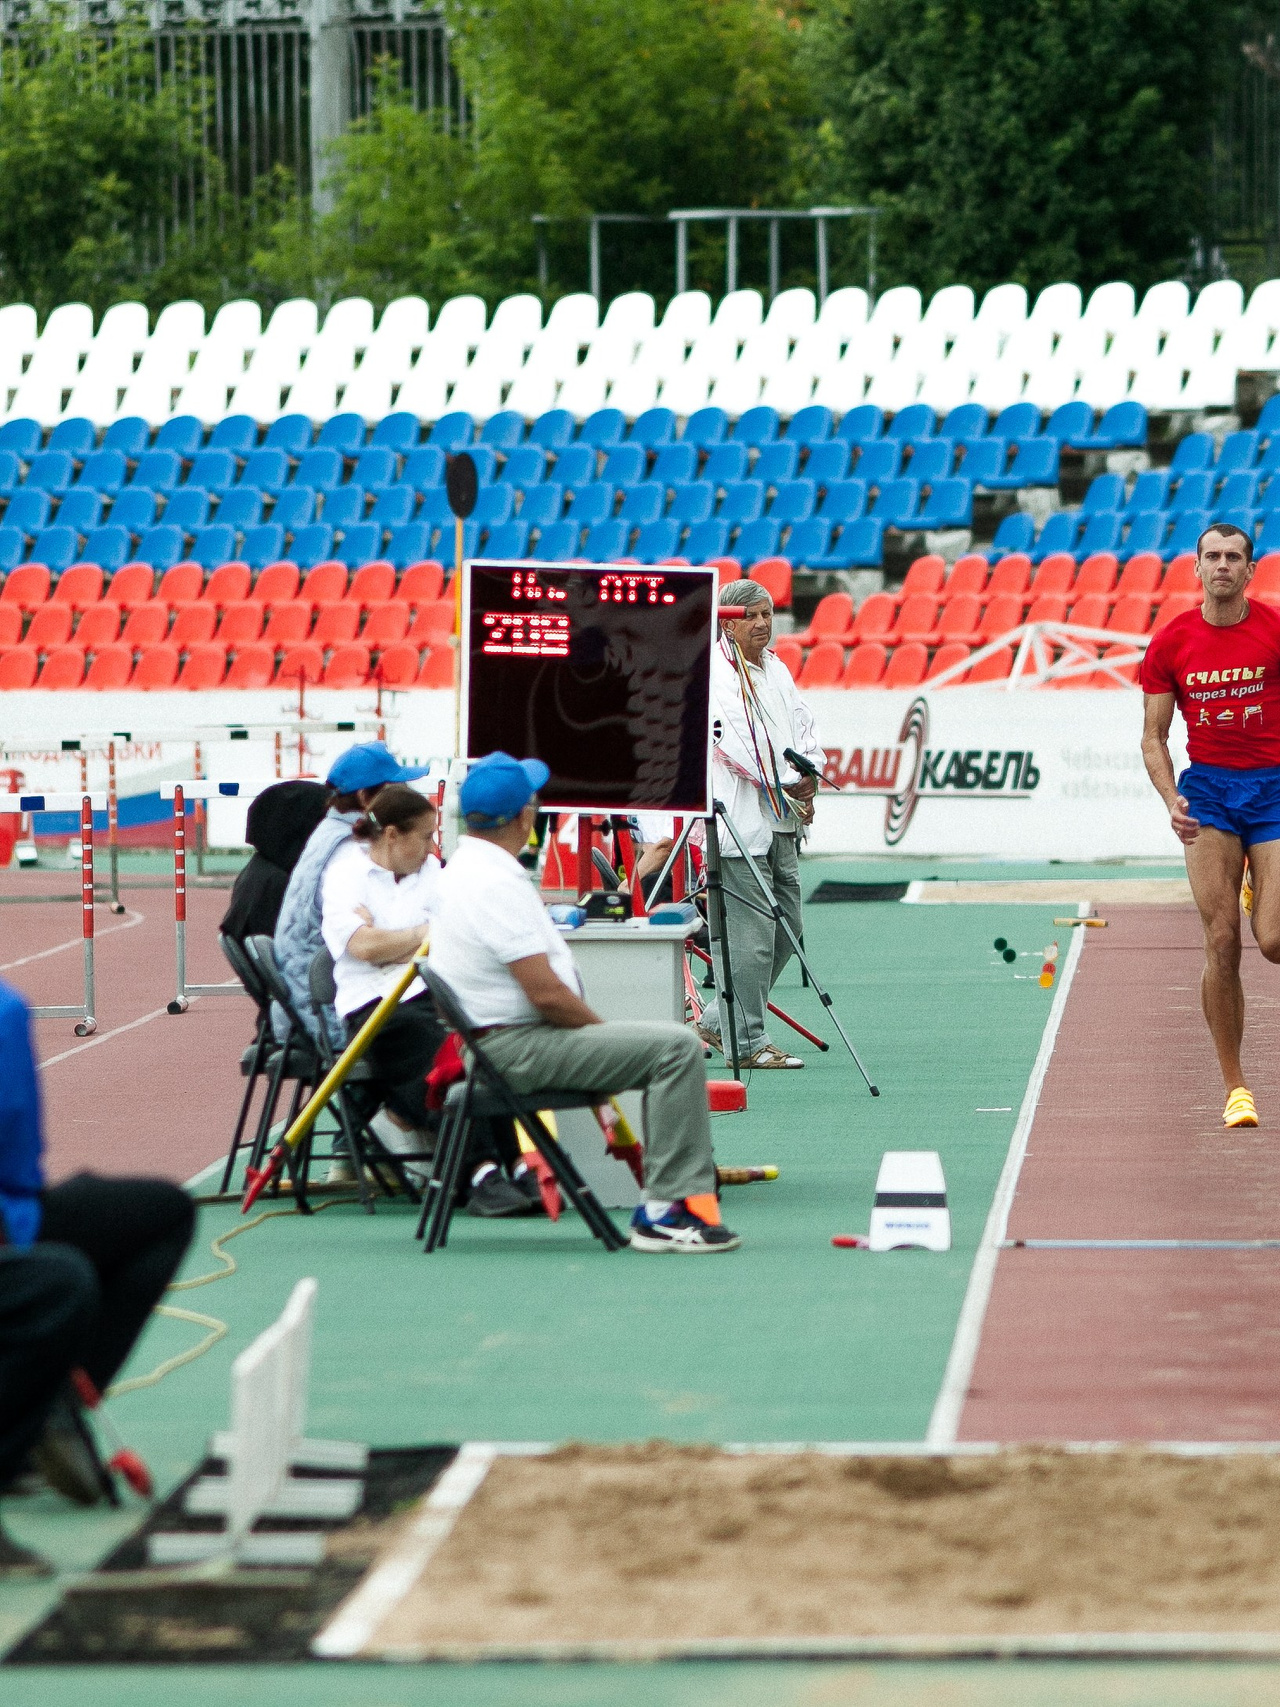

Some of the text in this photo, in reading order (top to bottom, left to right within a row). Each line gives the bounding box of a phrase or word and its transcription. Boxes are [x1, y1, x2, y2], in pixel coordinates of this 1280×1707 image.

[1186, 666, 1266, 686] СЧАСТЬЕ
[1189, 681, 1265, 702] через край
[917, 749, 1041, 791] КАБЕЛЬ
